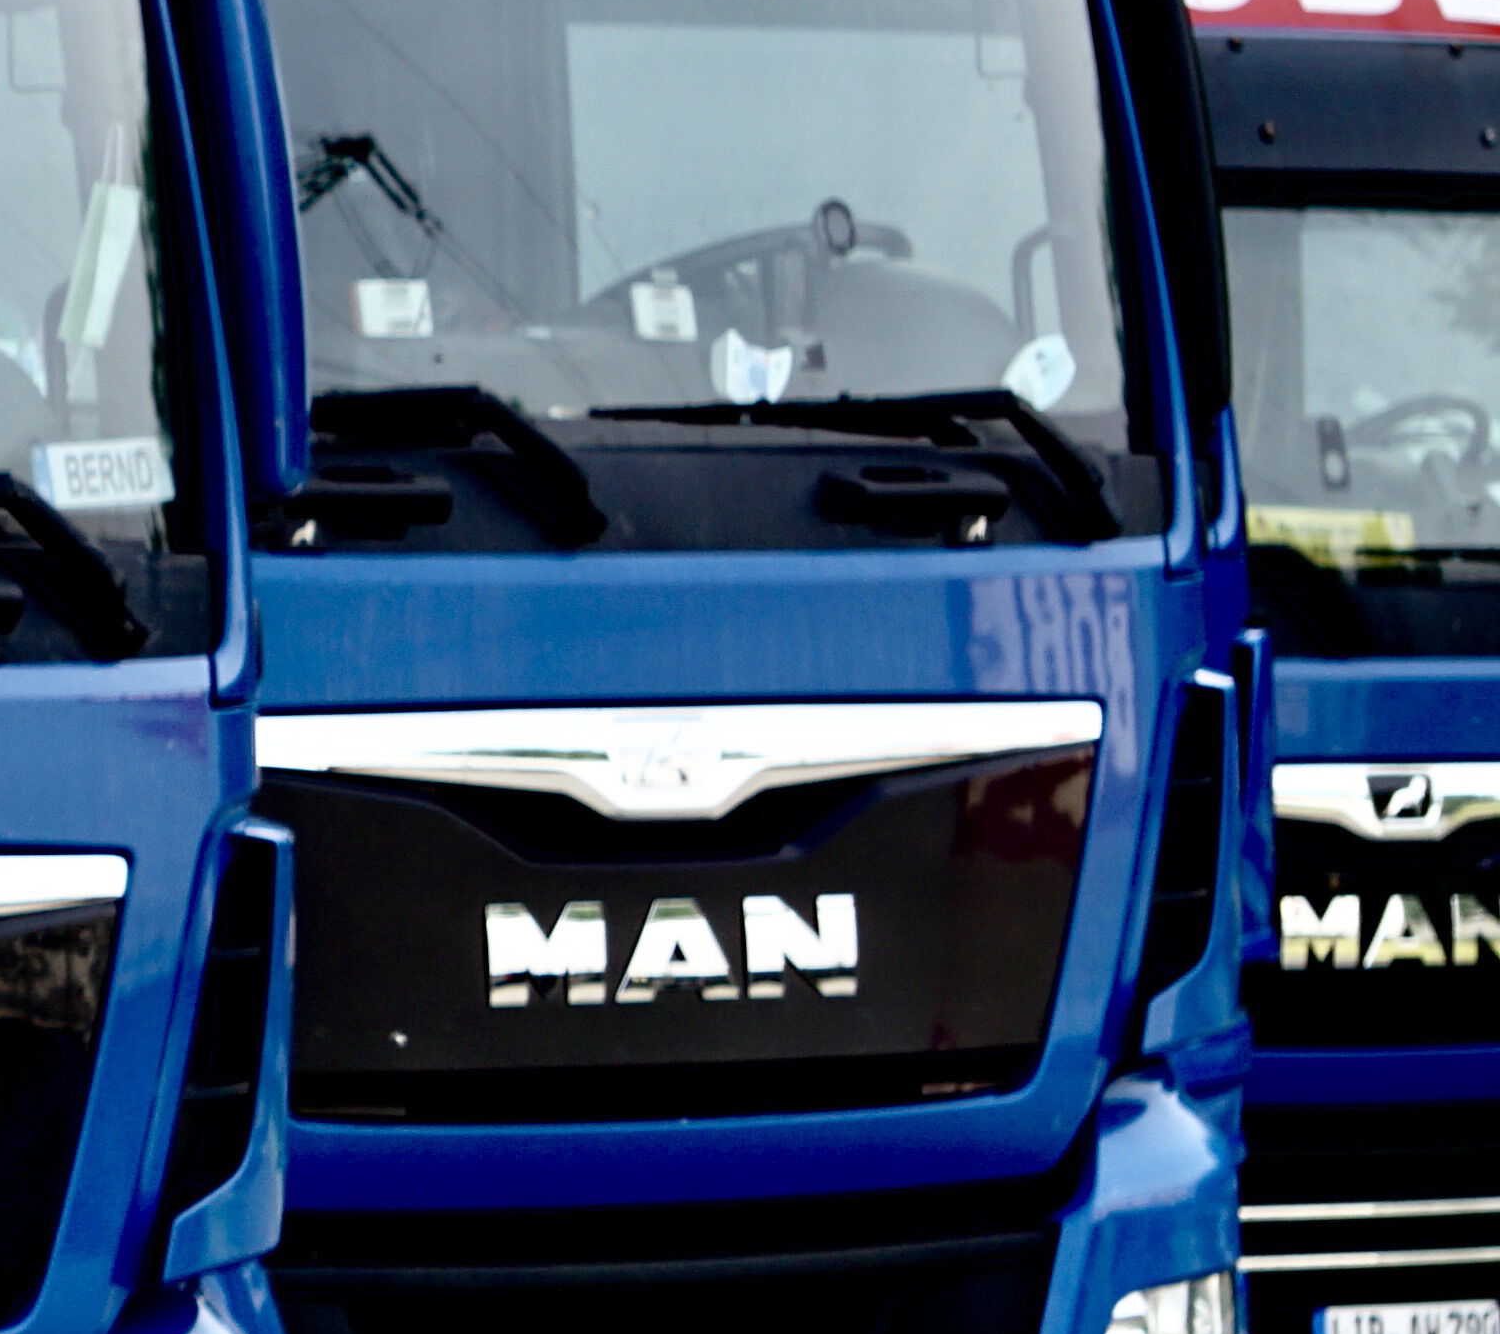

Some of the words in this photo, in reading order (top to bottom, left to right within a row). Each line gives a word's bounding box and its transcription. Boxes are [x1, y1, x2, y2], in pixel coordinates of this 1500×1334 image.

[64, 449, 153, 496] BERND
[484, 892, 860, 1008] MAN
[1279, 892, 1500, 970] MAN
